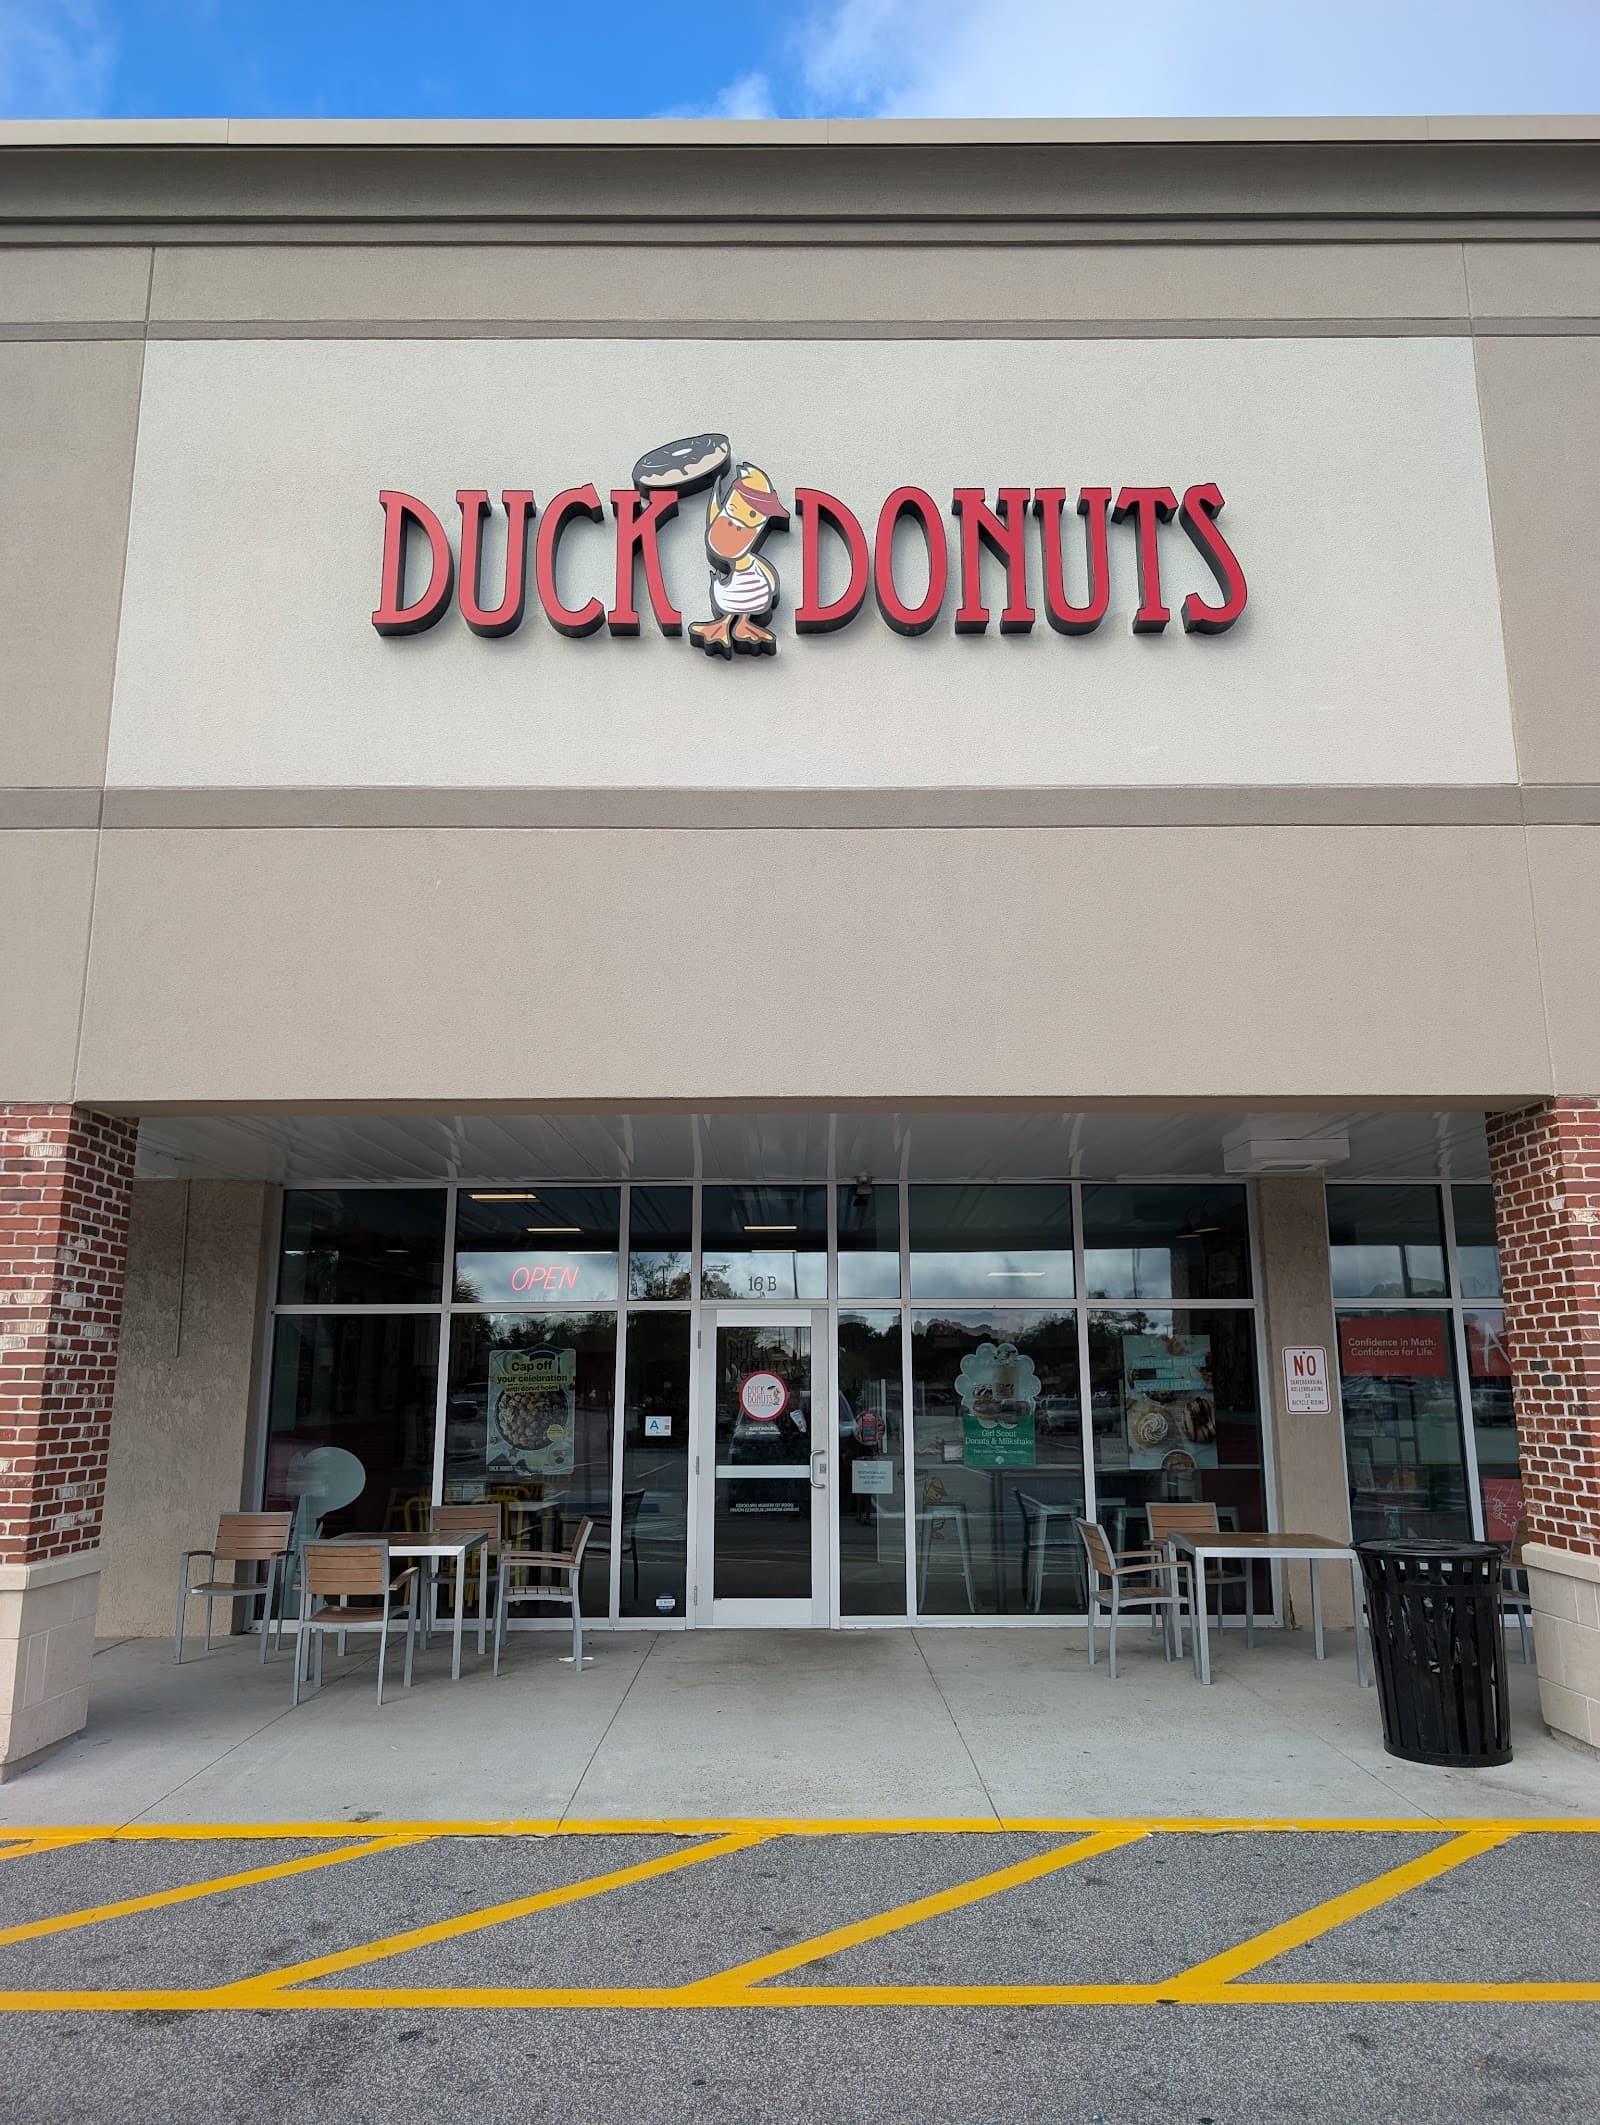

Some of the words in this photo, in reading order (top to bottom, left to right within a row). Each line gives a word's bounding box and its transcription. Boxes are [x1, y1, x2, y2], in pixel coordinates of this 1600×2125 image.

[372, 483, 682, 637] DUCK
[795, 483, 1248, 635] DONUTS
[511, 1265, 579, 1292] OPEN
[748, 1276, 764, 1291] 16
[768, 1275, 777, 1291] B
[1348, 1337, 1398, 1346] Confidence
[1400, 1337, 1408, 1346] in
[1411, 1337, 1436, 1346] Math.
[1351, 1347, 1399, 1356] Confidence
[1402, 1347, 1414, 1356] for
[511, 1361, 534, 1372] Cap
[536, 1360, 552, 1370] off
[1294, 1355, 1316, 1376] NO
[496, 1375, 516, 1385] your
[518, 1374, 568, 1382] celebration
[747, 1386, 765, 1396] DUCK
[649, 1420, 659, 1430] A
[981, 1429, 995, 1437] Girl
[995, 1429, 1017, 1437] Scout
[965, 1437, 990, 1445] Donuts
[991, 1437, 997, 1445] &
